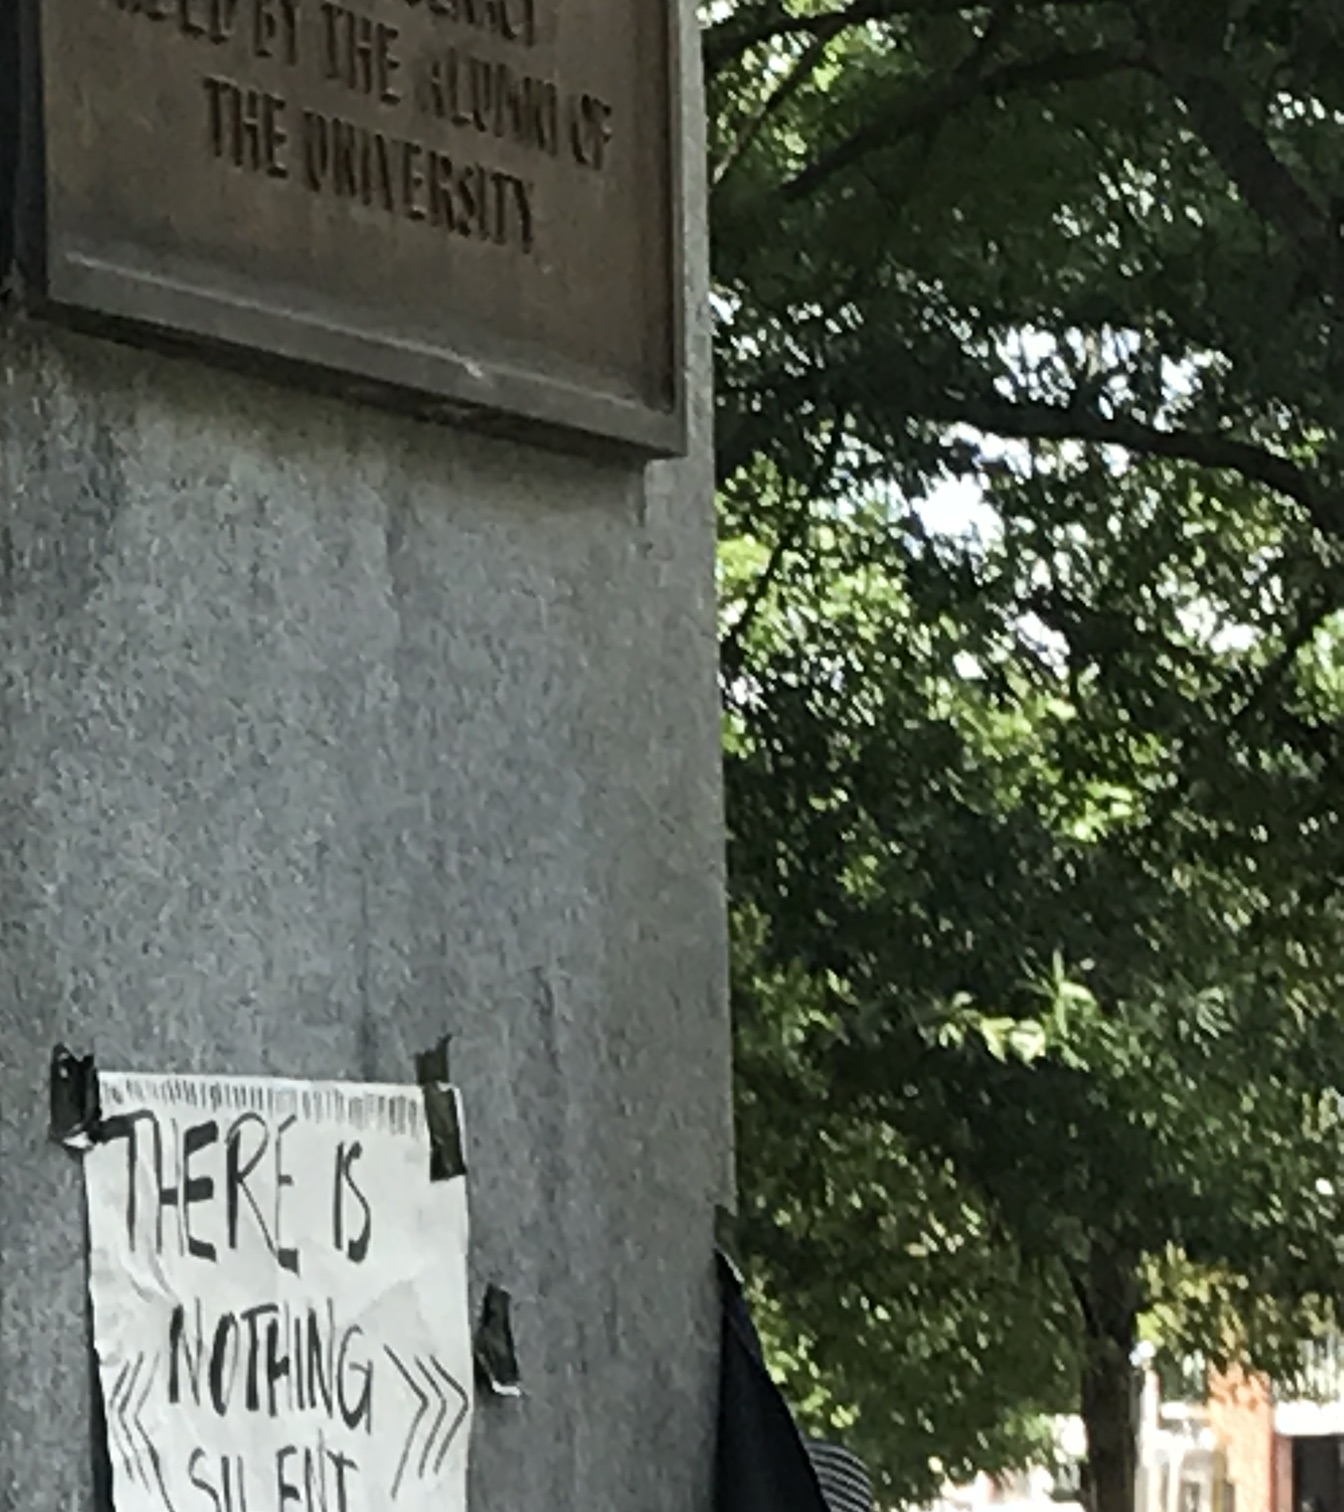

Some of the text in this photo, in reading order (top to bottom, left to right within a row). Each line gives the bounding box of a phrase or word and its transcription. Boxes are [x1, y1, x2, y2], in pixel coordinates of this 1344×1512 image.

[202, 77, 534, 254] THE UNIVERSITY
[321, 2, 400, 105] THE
[415, 46, 558, 157] ALUMNI
[568, 93, 612, 170] OF
[89, 1108, 372, 1278] THERE IS
[167, 1297, 374, 1435] NOTHING
